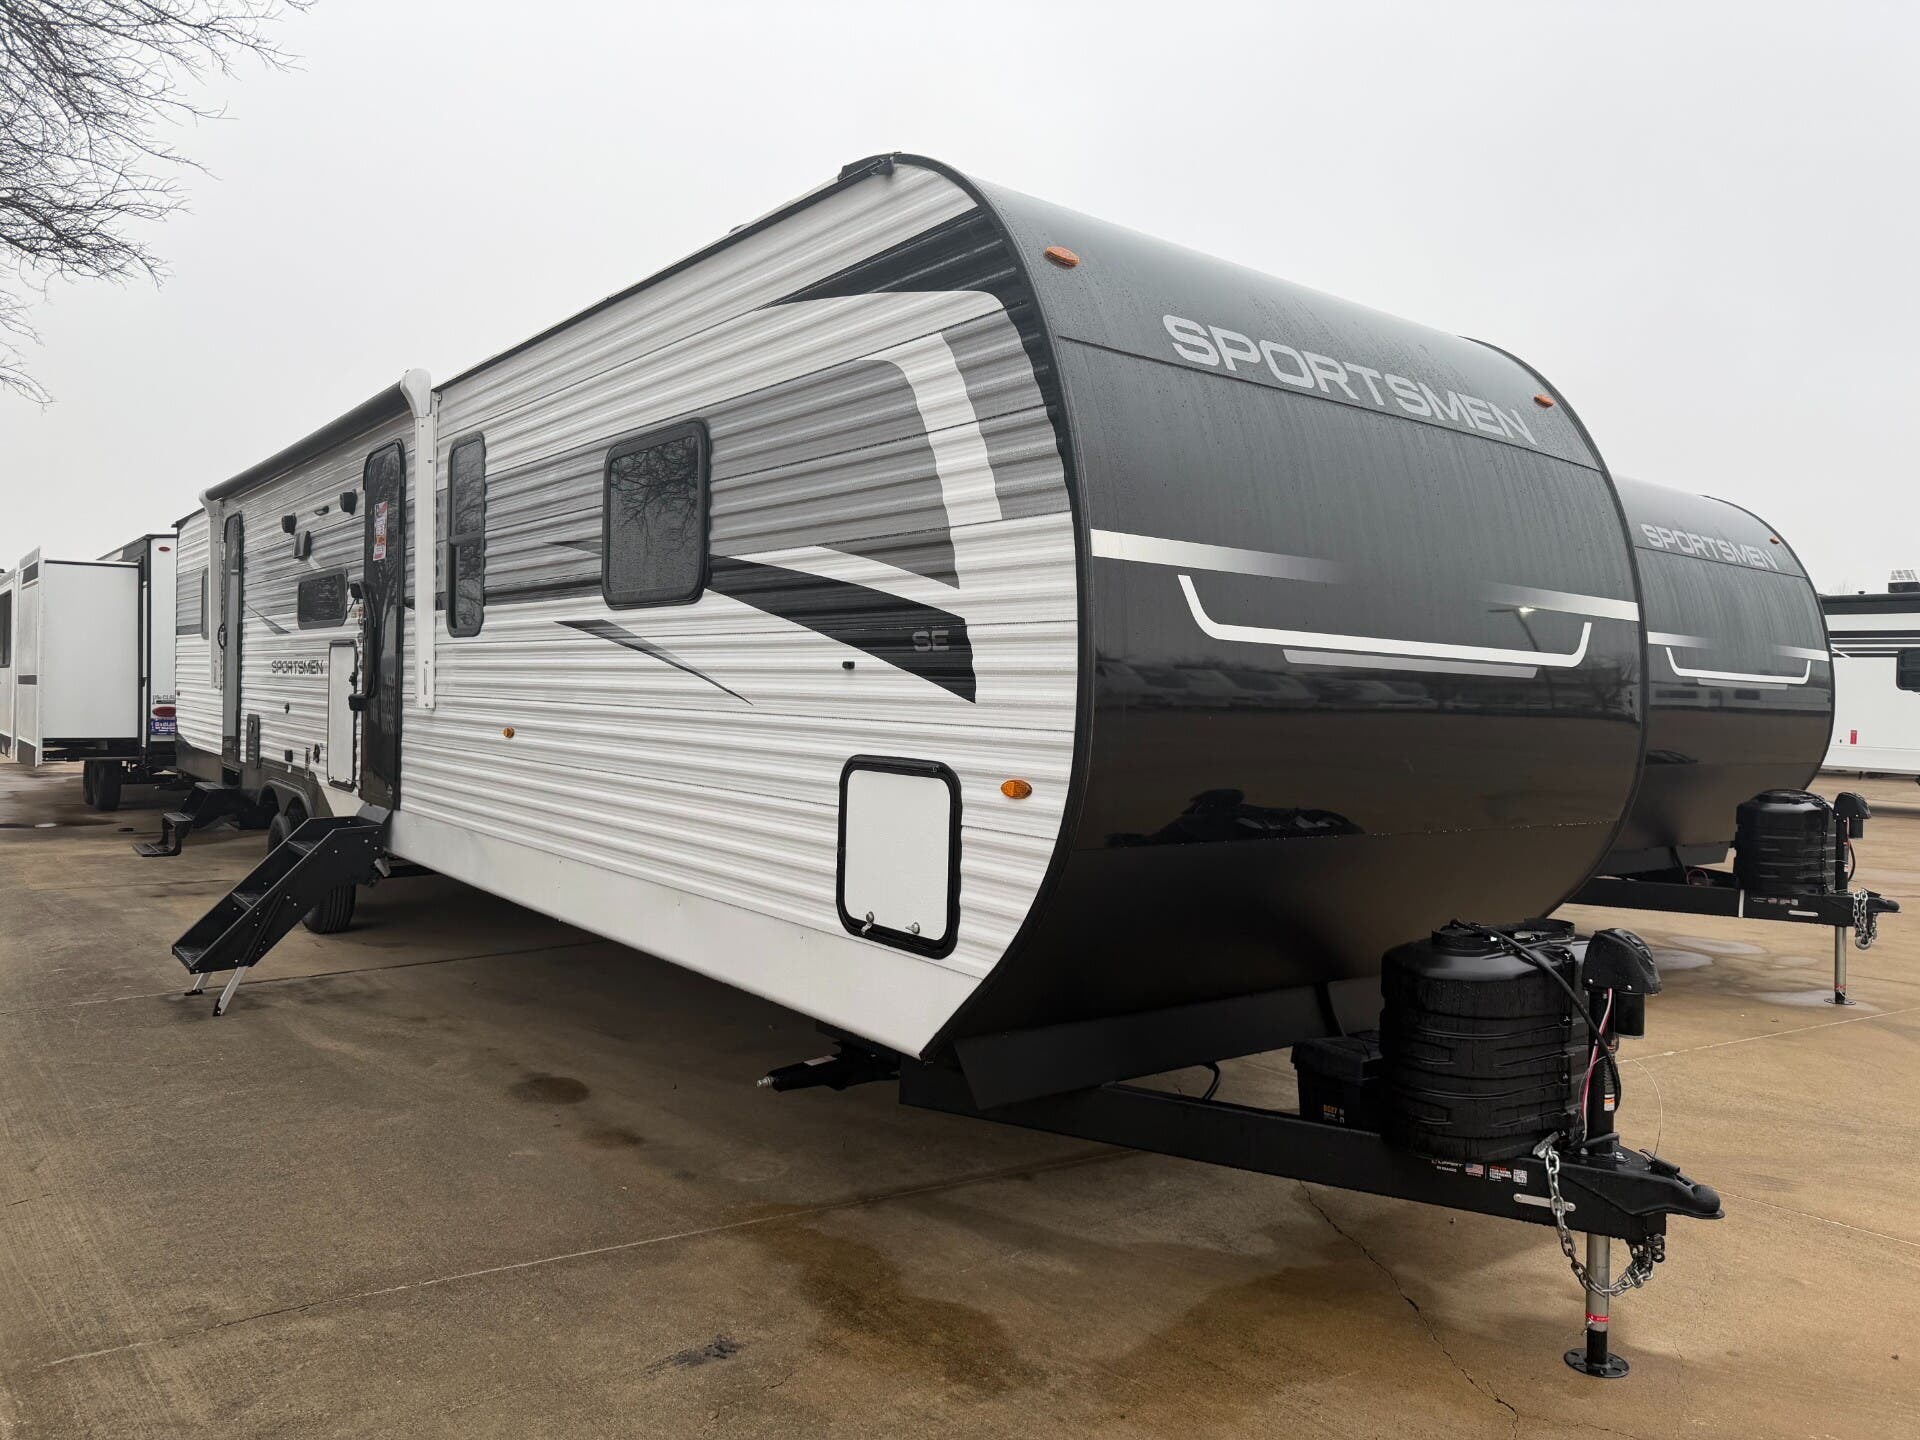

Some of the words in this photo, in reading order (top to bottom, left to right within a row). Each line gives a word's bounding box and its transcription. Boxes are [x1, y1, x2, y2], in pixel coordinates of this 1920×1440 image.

[1163, 314, 1537, 445] SPORTSMEN
[1640, 523, 1778, 570] SPORTSMEN
[912, 630, 950, 651] SE
[271, 659, 324, 674] SPORTSMEN
